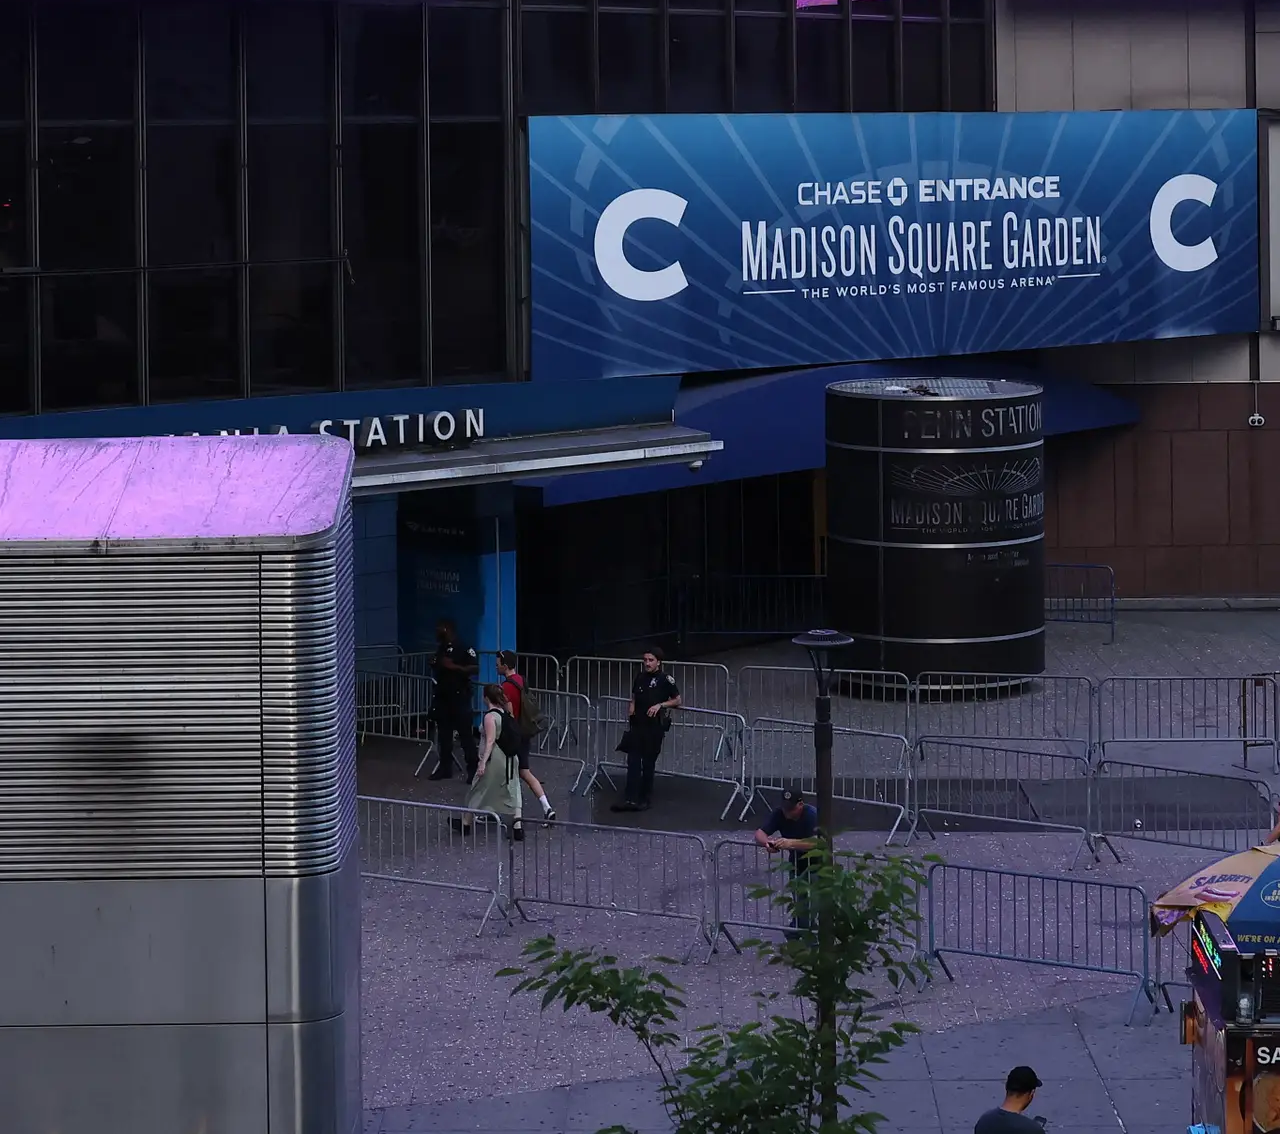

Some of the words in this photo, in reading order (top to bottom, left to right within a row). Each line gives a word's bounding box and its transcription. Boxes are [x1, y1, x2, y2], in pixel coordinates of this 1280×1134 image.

[798, 181, 881, 205] CHASE
[920, 176, 1059, 202] ENTRANCE
[1150, 174, 1218, 271] C
[595, 189, 688, 301] C
[742, 220, 876, 281] MADISON
[888, 215, 992, 278] SQUARE
[802, 287, 829, 299] THE
[836, 283, 901, 297] WORLD'S
[907, 281, 947, 294] MOST
[951, 279, 1005, 292] FAMOUS
[320, 408, 485, 448] STATION
[1191, 873, 1253, 892] SABRETT
[1237, 934, 1263, 944] WE'RE
[1263, 936, 1274, 945] ON
